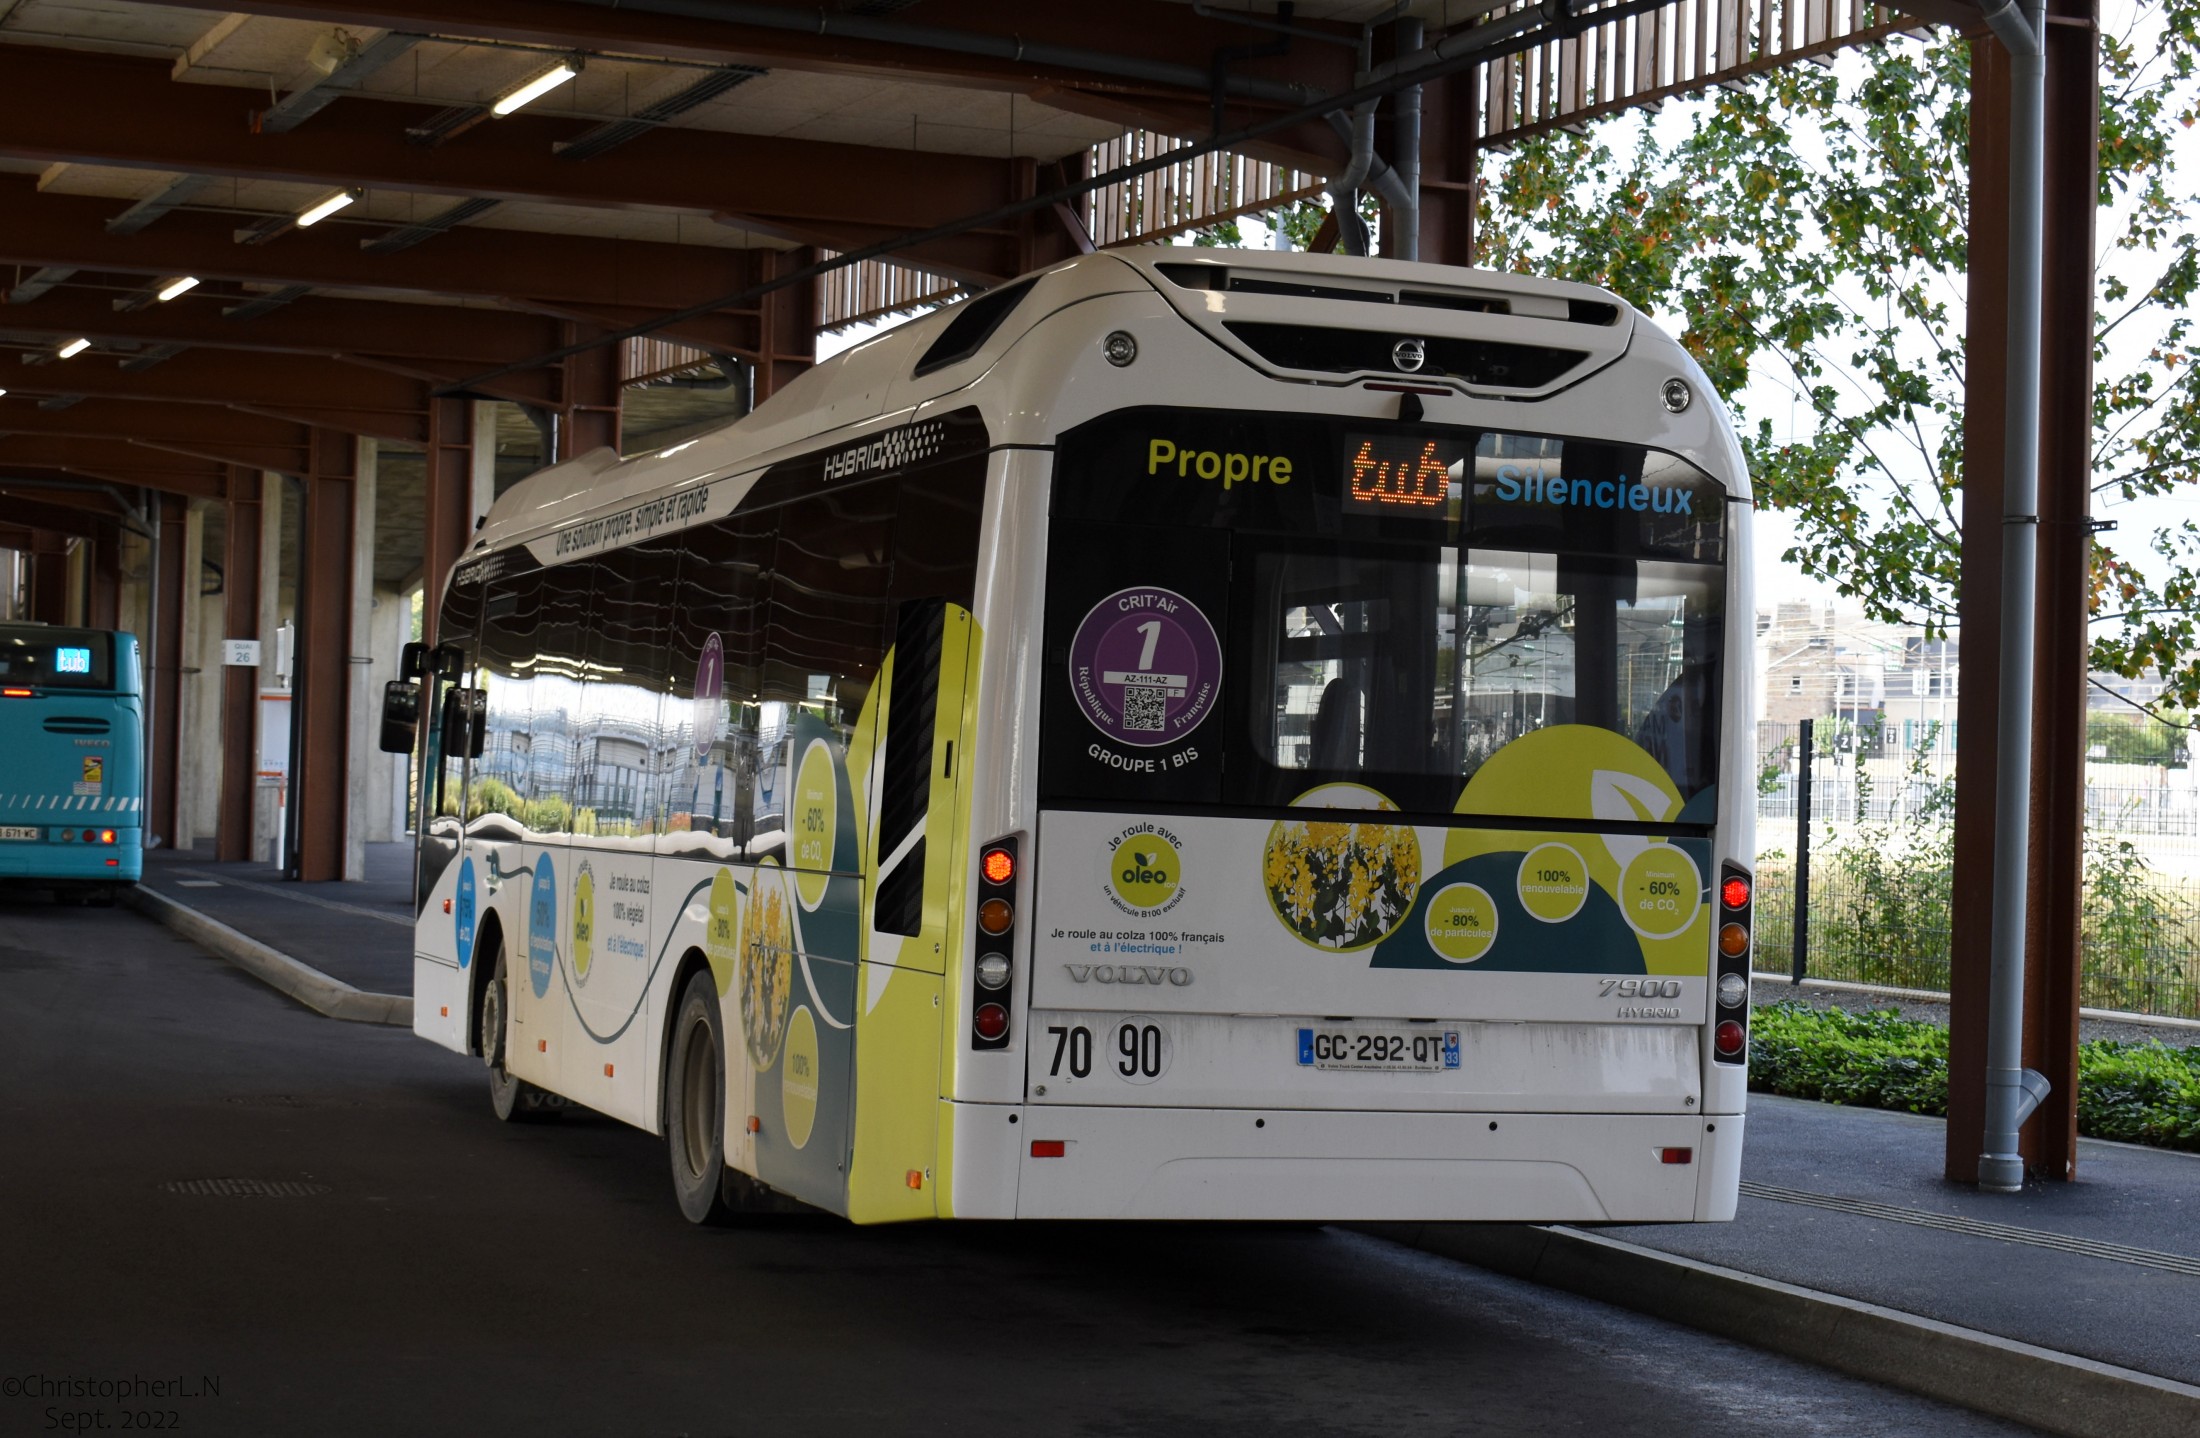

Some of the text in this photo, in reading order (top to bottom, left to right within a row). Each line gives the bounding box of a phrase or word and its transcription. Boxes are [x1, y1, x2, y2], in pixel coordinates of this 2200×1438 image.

[823, 441, 883, 481] HYBRID
[1149, 438, 1293, 491] Propre
[1352, 441, 1449, 506] tub
[1495, 463, 1693, 516] Silencieux
[556, 530, 572, 556] Une
[572, 519, 603, 552] solution
[635, 497, 665, 536] simple
[666, 494, 678, 523] et
[677, 482, 709, 526] rapide
[1118, 594, 1179, 614] CRIT'Air
[235, 652, 250, 663] 26
[1136, 620, 1161, 671] 1
[59, 648, 86, 672] tub
[706, 657, 714, 697] 1
[1124, 674, 1168, 685] AZ-111-AZ
[1079, 666, 1211, 728] République Française
[1088, 743, 1199, 773] GROUPE 1 BIS
[807, 808, 825, 833] 60%
[1107, 822, 1183, 852] Je roule avec
[801, 841, 809, 859] de
[610, 872, 650, 894] Je roule au colza
[1122, 865, 1167, 884] oleo
[1536, 870, 1571, 883] 100%
[1645, 870, 1675, 879] Minimum
[1520, 883, 1584, 895] renouvelable
[1649, 881, 1681, 896] 60%
[1103, 884, 1186, 918] un véhicule B100 exclusif
[1639, 899, 1653, 911] de
[613, 901, 645, 927] 100% végétal
[1452, 916, 1480, 927] 80%
[1051, 928, 1225, 945] Je roule au colza 100% français
[1430, 927, 1492, 939] de particules
[1090, 943, 1101, 952] et
[1104, 942, 1111, 952] à
[1114, 942, 1175, 956] l'électrique
[1063, 963, 1196, 987] VOLVO
[1599, 979, 1683, 998] 7900
[1617, 1007, 1681, 1019] HYBRID
[1048, 1026, 1092, 1079] 70
[1119, 1023, 1161, 1078] 90
[1303, 1034, 1459, 1065] F GC-292-QT 33
[792, 1053, 810, 1077] 100%
